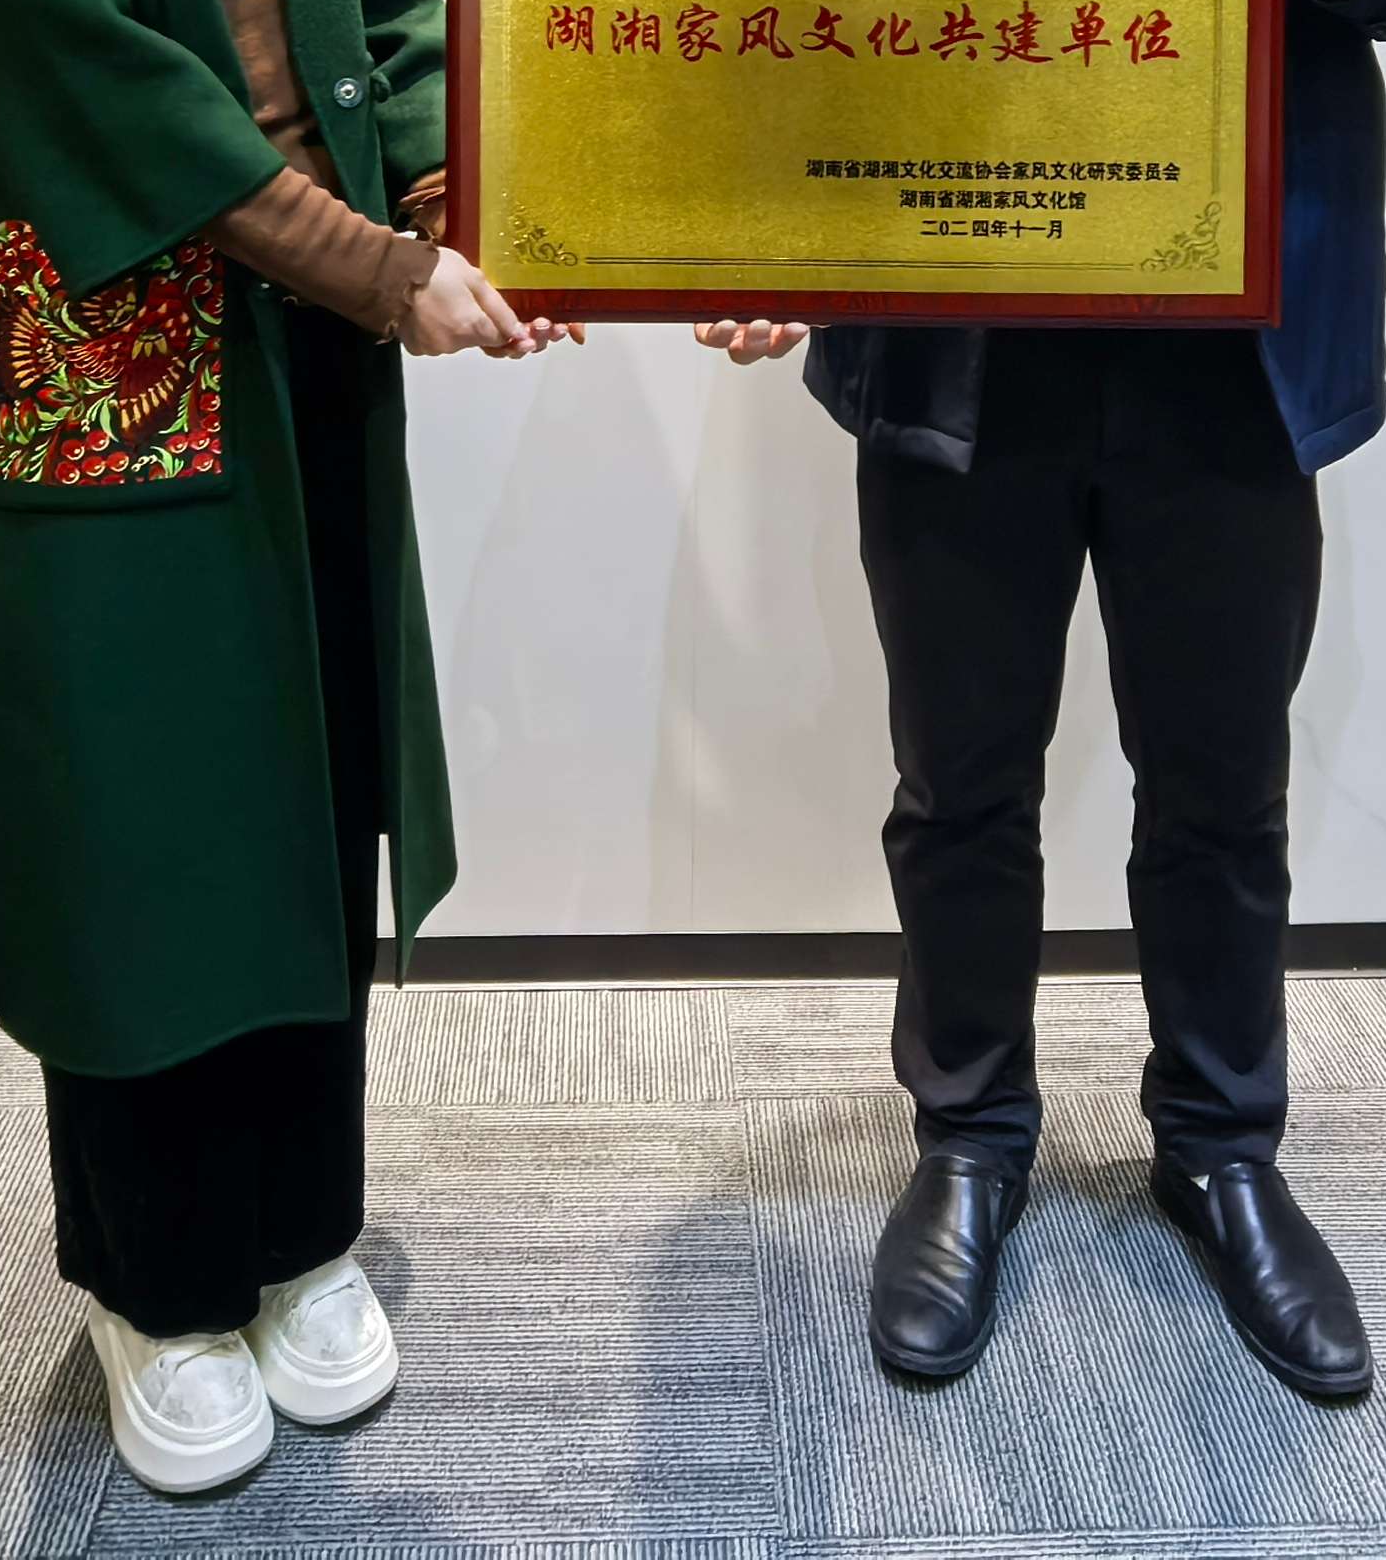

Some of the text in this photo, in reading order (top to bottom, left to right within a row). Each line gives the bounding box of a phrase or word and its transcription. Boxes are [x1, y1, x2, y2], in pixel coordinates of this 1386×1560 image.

[545, 1, 1181, 67] 湖湘家风文化共建单位
[806, 159, 1181, 182] 湖南省湖湘文化交流协会家风文化研究委员会
[899, 190, 1087, 210] 湖南省湖湘家风文化馆
